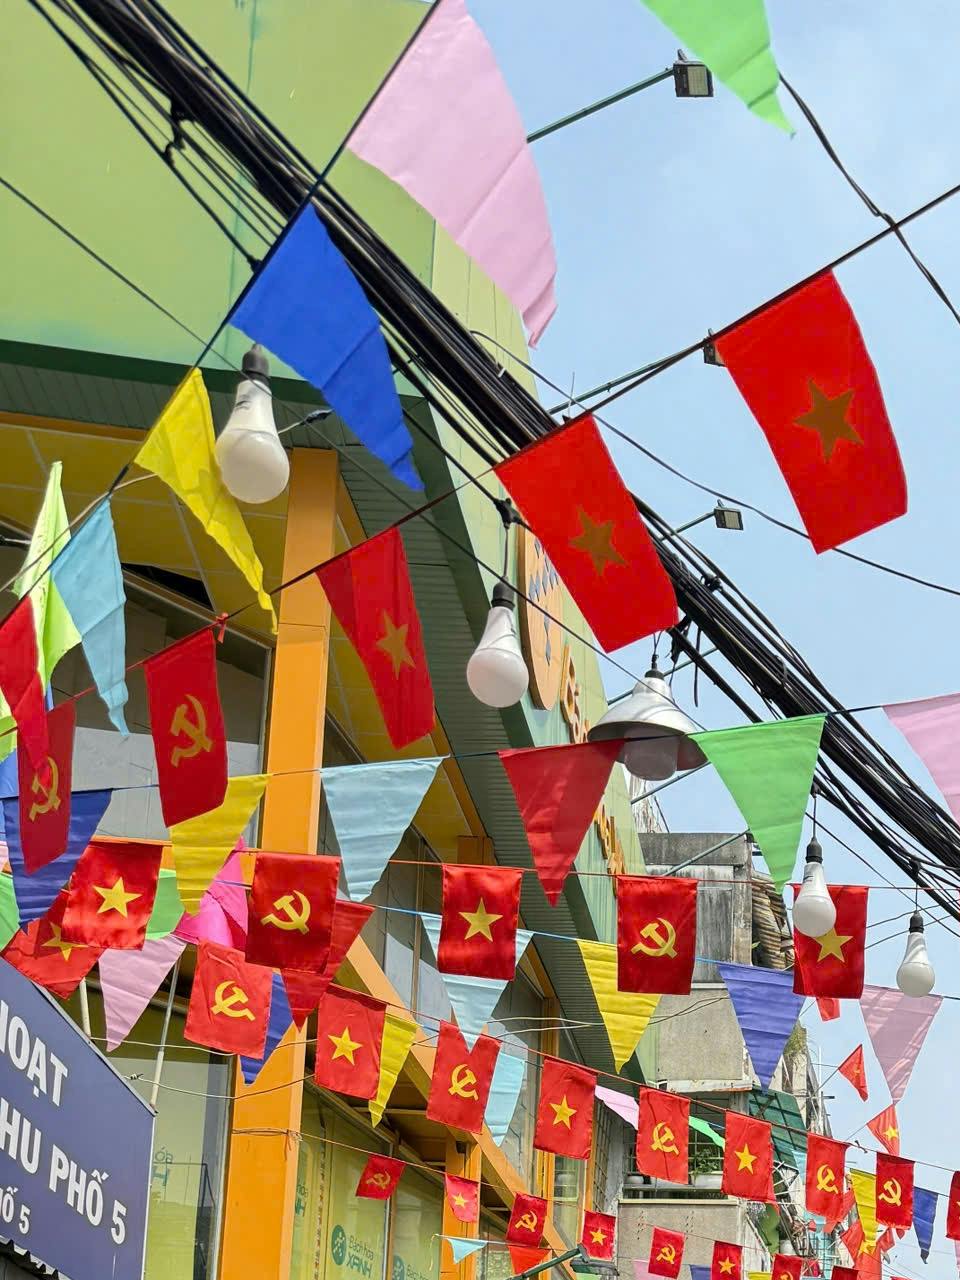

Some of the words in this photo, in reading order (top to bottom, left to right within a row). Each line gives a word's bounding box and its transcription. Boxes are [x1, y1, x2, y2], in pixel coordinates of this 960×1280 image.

[0, 1096, 41, 1175] HU
[49, 1144, 110, 1227] PHỐ
[111, 1199, 127, 1246] 5
[19, 1204, 31, 1235] 5
